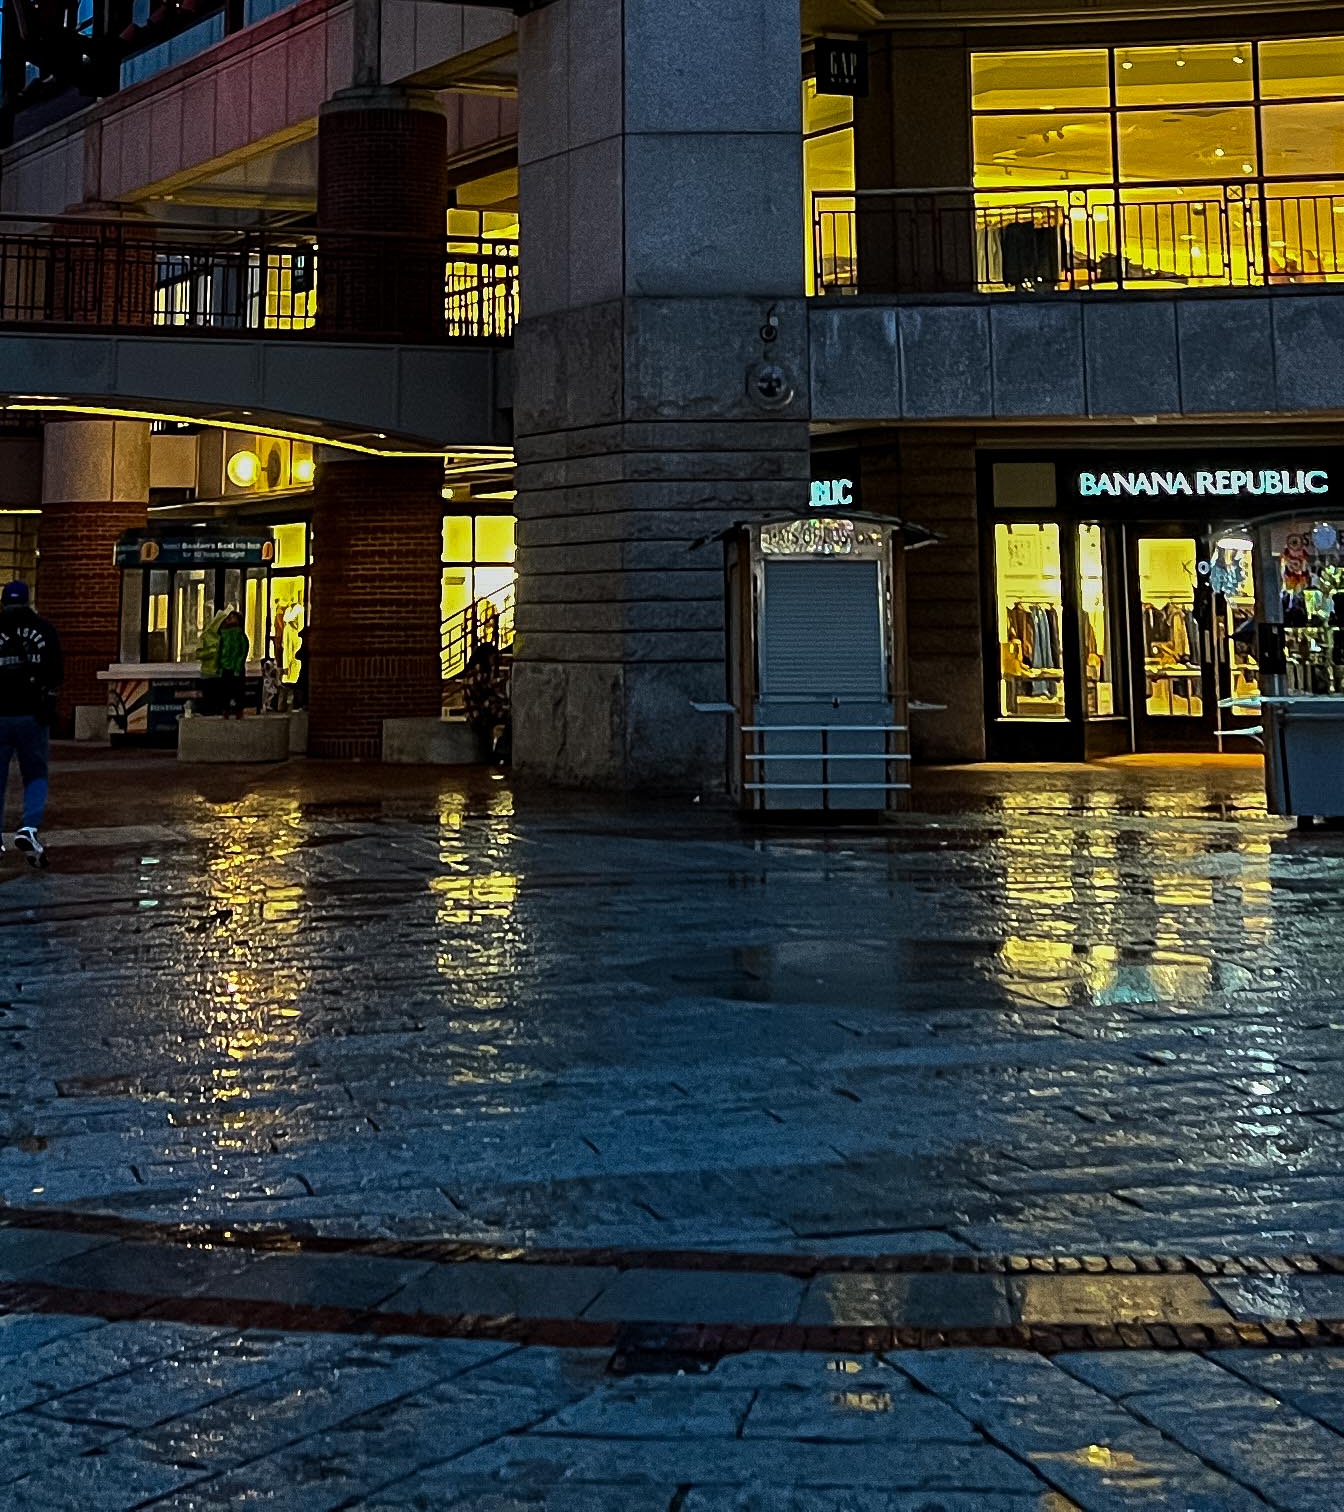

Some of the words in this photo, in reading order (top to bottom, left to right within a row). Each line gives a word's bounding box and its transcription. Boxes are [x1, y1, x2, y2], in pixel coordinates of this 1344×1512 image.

[830, 50, 858, 76] GAP
[1079, 471, 1193, 496] BANANA
[1196, 469, 1329, 496] REPUBLIC
